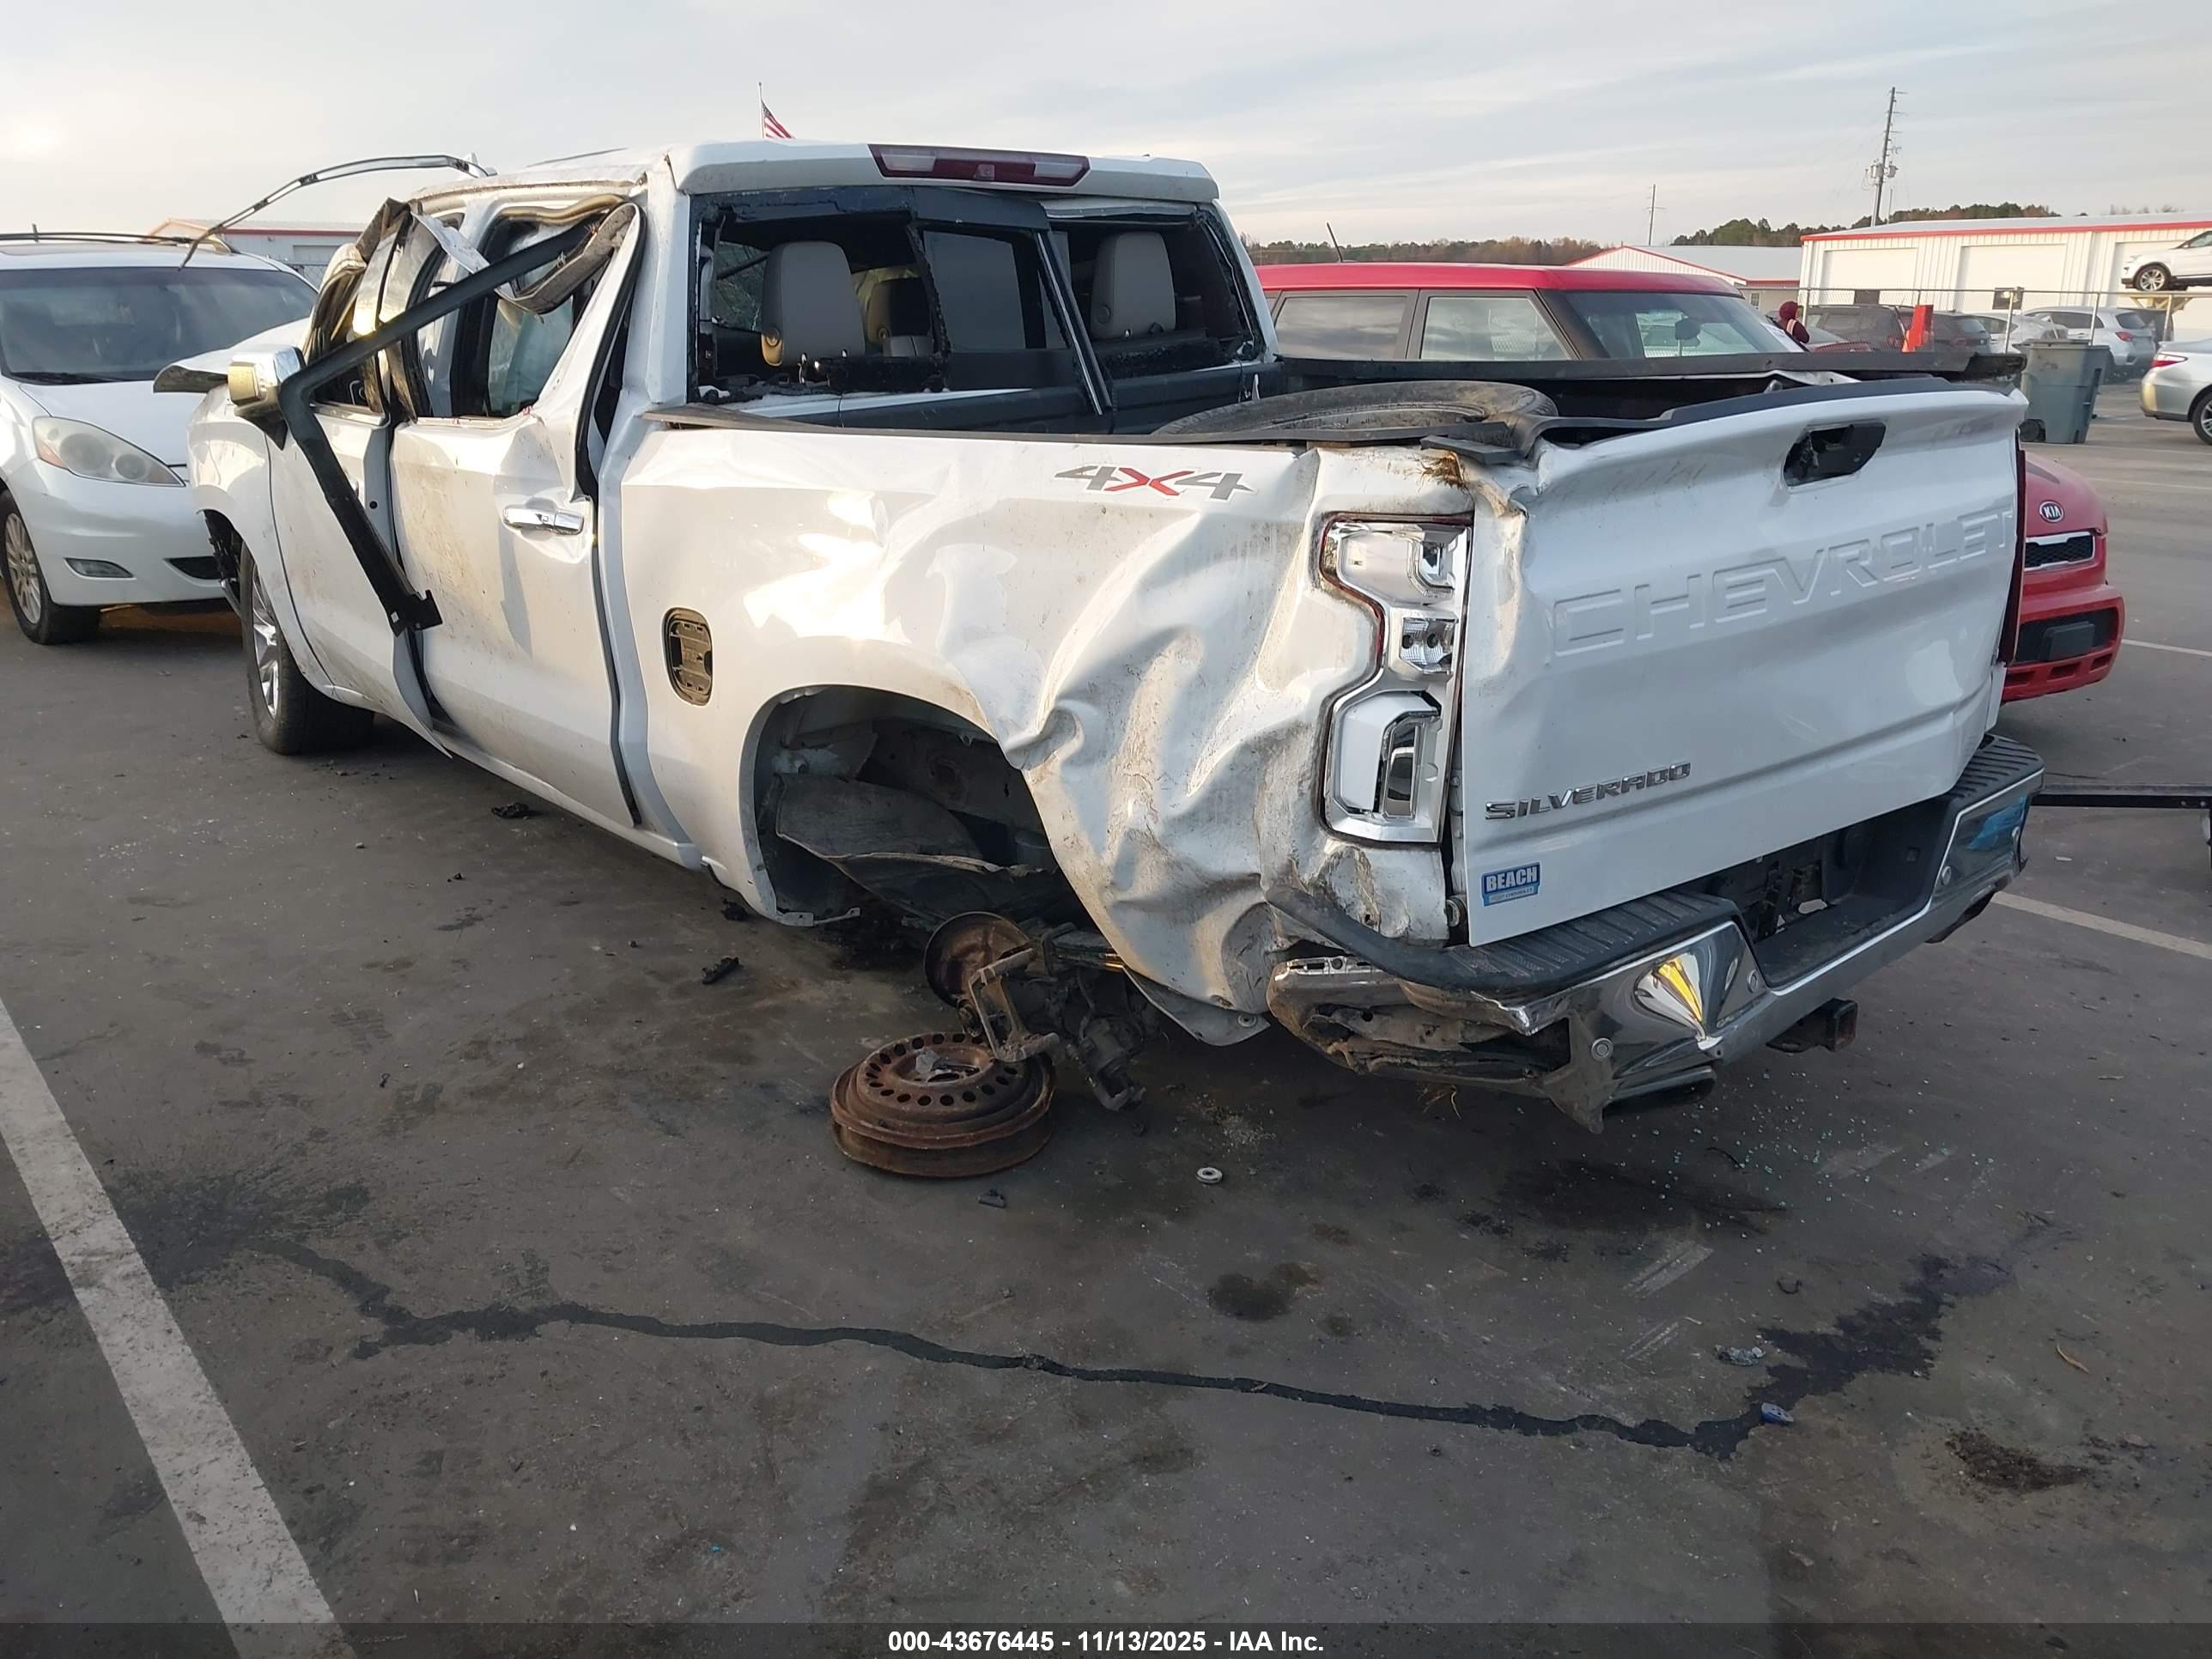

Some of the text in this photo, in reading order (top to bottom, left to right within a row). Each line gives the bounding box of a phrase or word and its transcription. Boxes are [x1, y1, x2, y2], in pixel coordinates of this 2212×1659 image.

[1552, 504, 2014, 658] CHEVROLET
[1485, 762, 1692, 821] SILVERADO
[1486, 866, 1537, 892] BEACH
